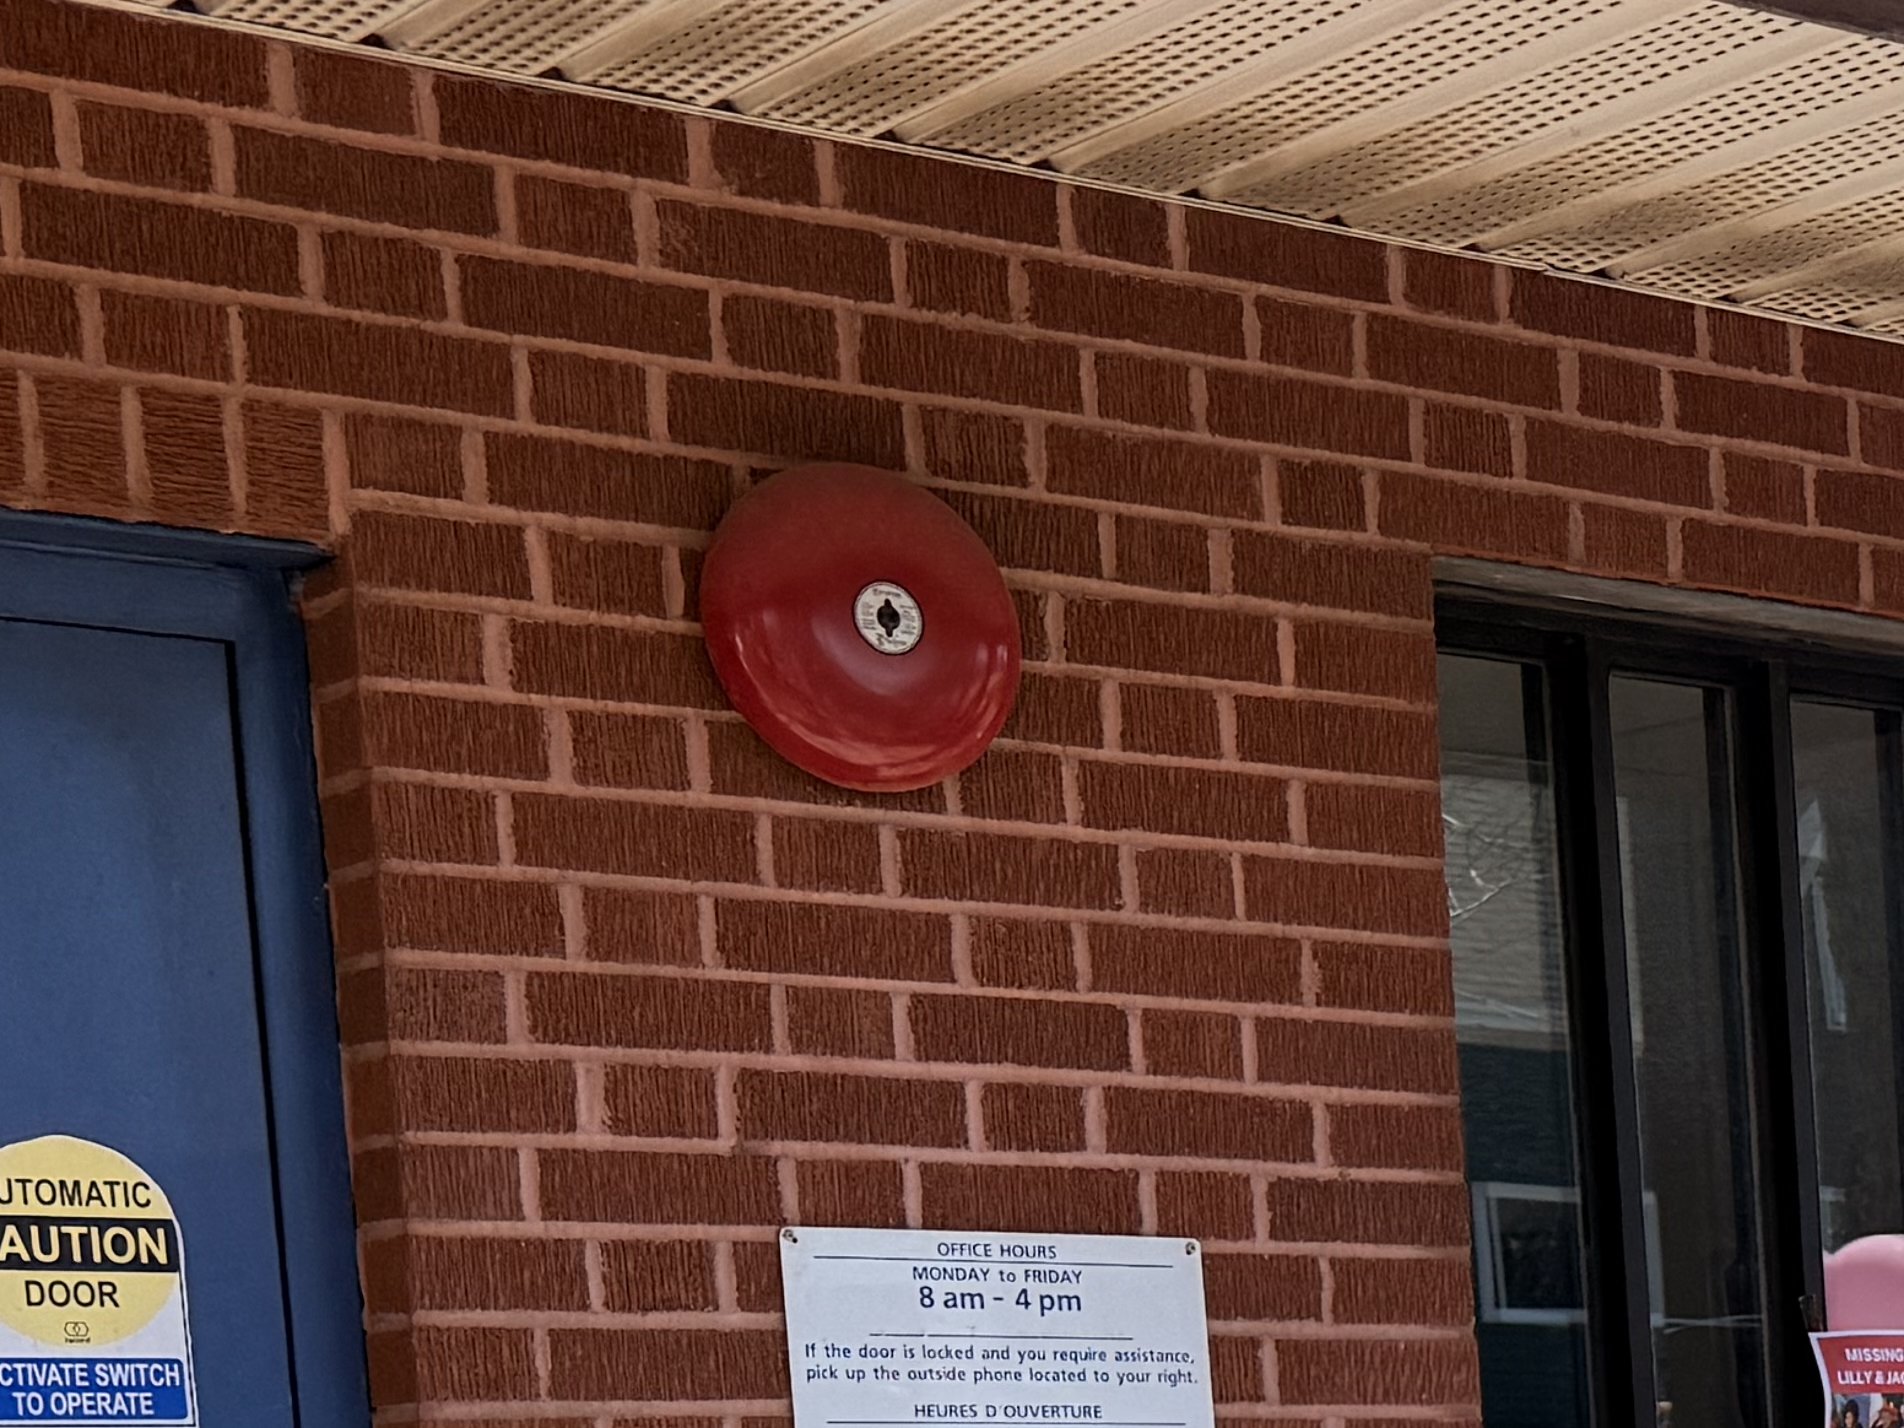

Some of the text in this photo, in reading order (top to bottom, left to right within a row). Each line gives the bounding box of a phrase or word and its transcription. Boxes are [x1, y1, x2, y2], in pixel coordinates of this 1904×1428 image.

[0, 1178, 152, 1208] UTOMATIC
[0, 1224, 169, 1265] AUTION
[937, 1242, 1057, 1260] OFFICE HOURS
[912, 1266, 1083, 1284] MONDAY to FRIDAY
[24, 1280, 120, 1308] DOOR
[919, 1285, 935, 1309] 8
[943, 1291, 985, 1310] am
[1015, 1288, 1032, 1310] 4
[1039, 1293, 1082, 1317] pm
[805, 1342, 1195, 1364] If the door is locked and you require assistance,
[1845, 1348, 1904, 1364] MISSING
[0, 1363, 180, 1387] CTIVATE SWITCH
[806, 1364, 1199, 1388] pick up the outside phone located to your right.
[1837, 1371, 1873, 1385] LILLY
[1875, 1371, 1884, 1385] &
[12, 1391, 155, 1416] TO OPERATE
[914, 1404, 978, 1418] HEURES
